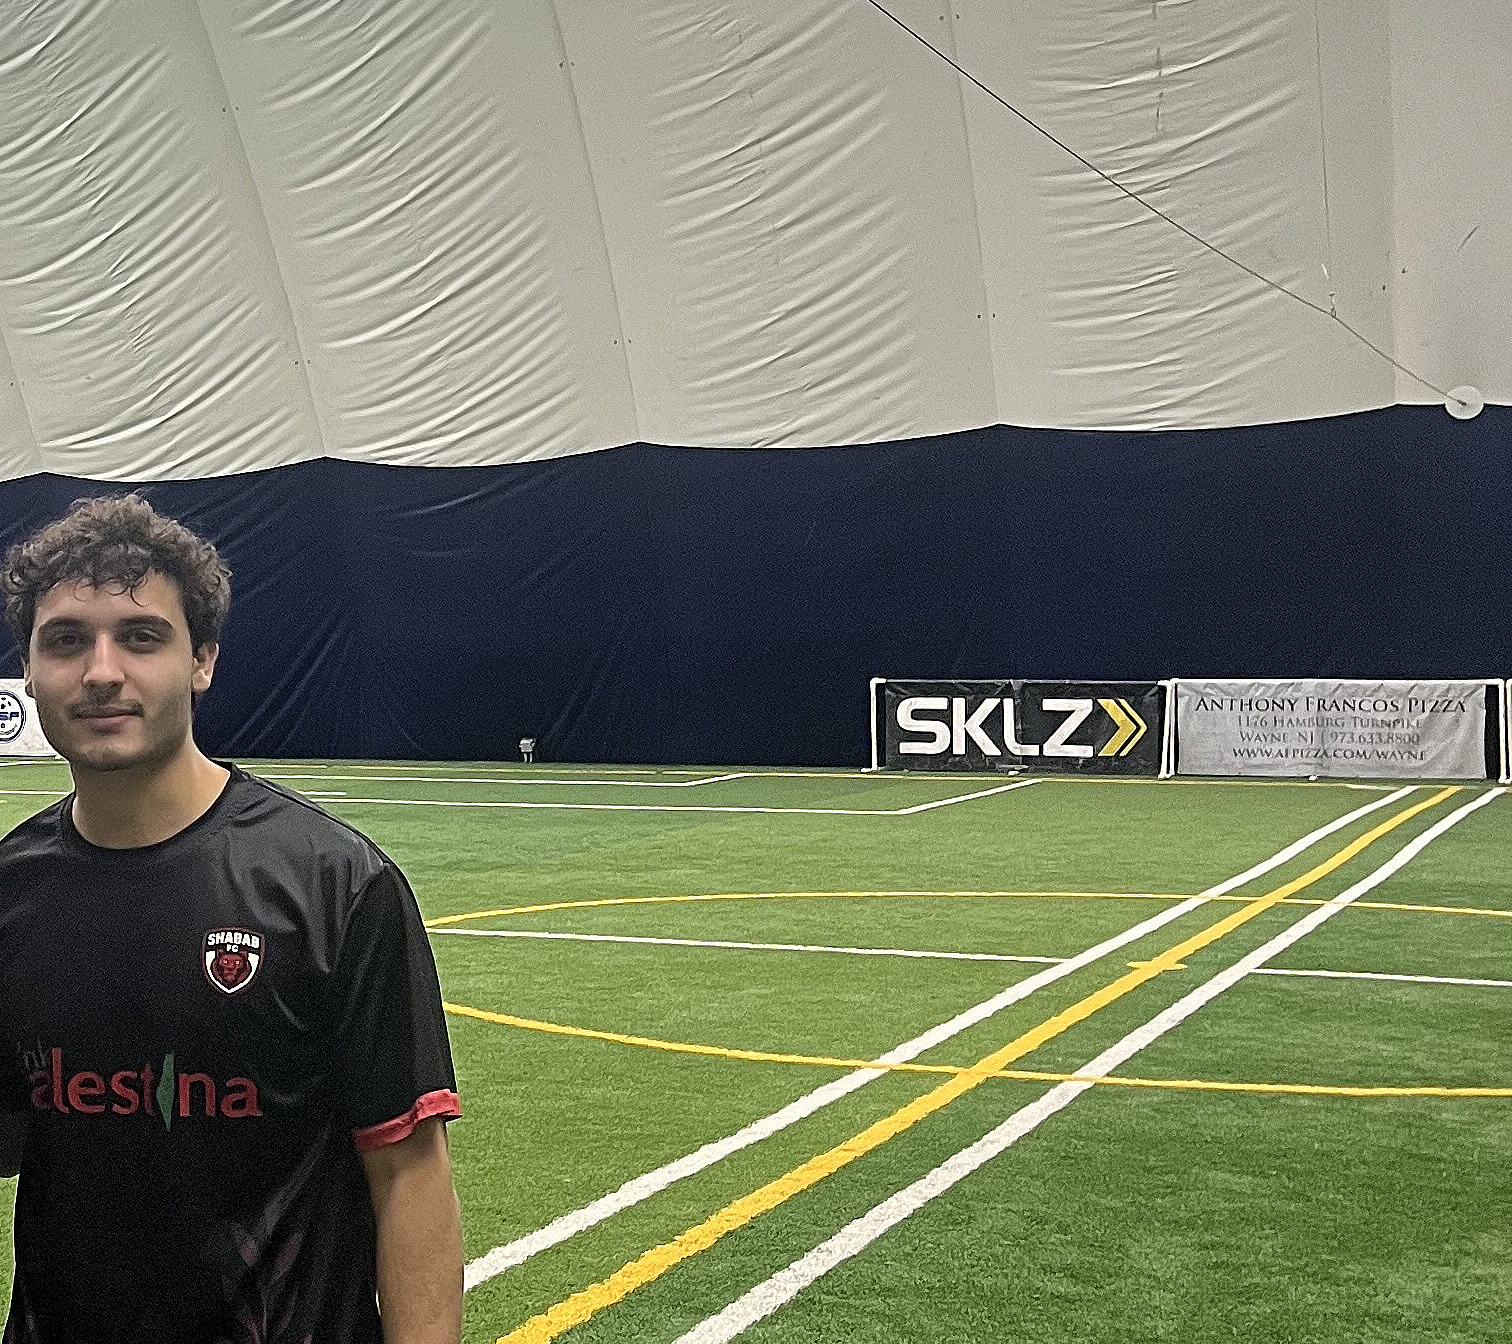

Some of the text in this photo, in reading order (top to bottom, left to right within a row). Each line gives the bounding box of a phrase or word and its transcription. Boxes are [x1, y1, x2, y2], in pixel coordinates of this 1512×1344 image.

[1195, 696, 1299, 712] ANTHONY
[1408, 697, 1466, 713] PIZZA
[897, 697, 1094, 757] SKLZ
[207, 931, 260, 949] SHABAB
